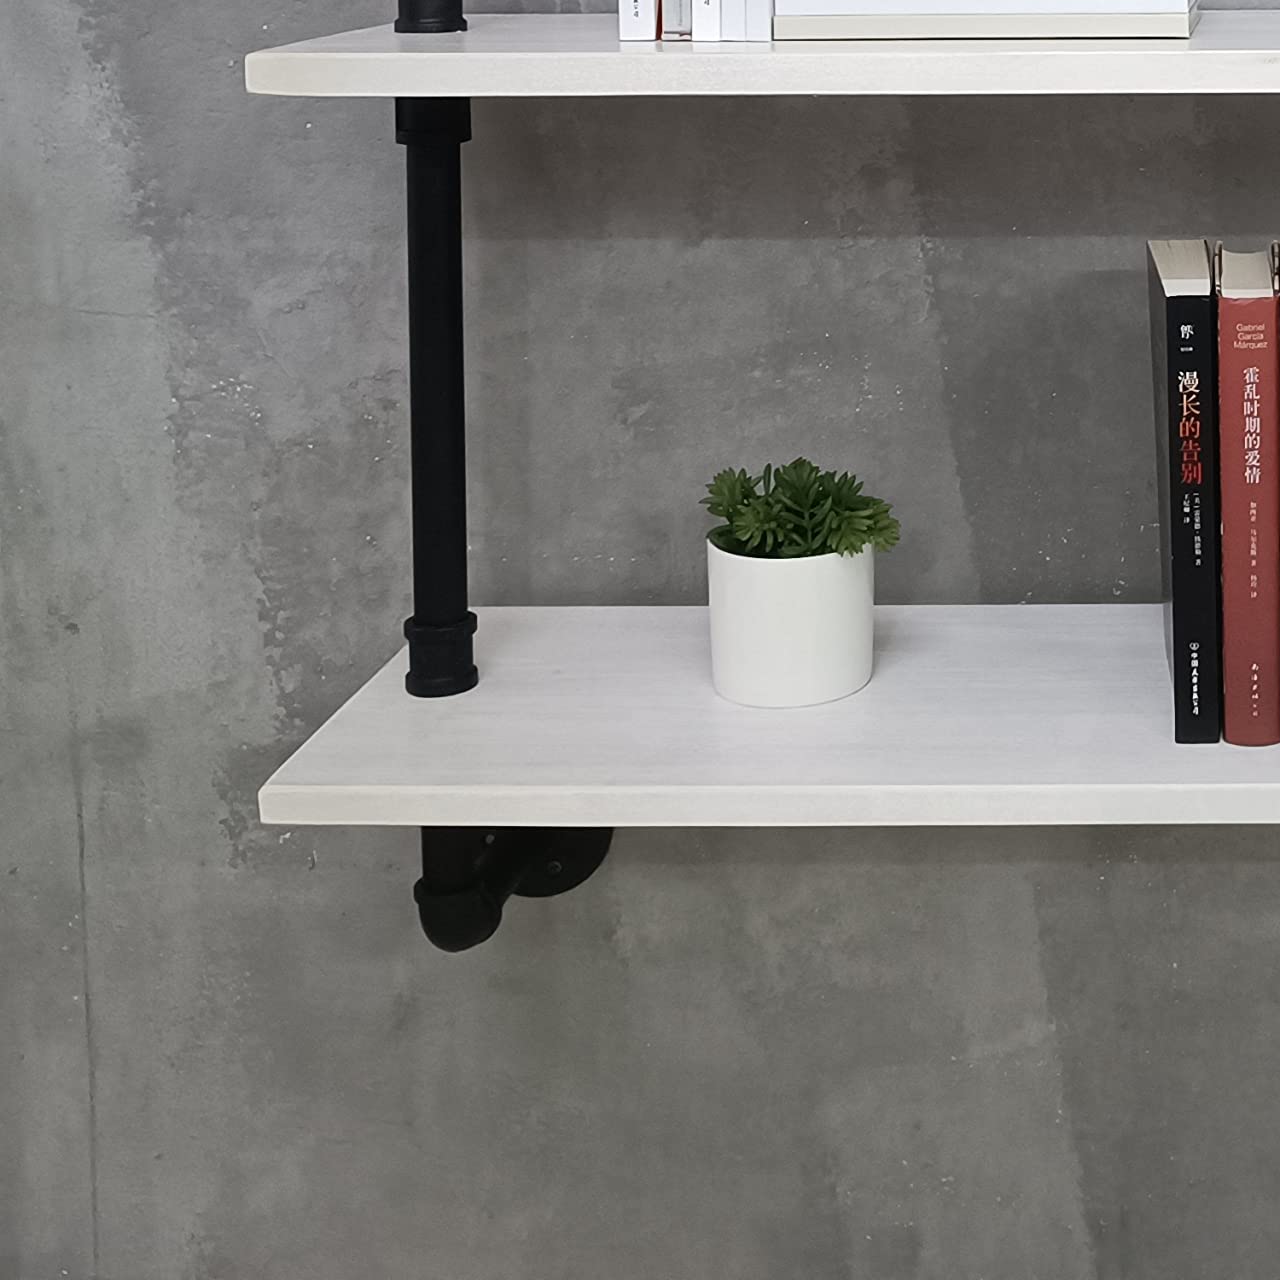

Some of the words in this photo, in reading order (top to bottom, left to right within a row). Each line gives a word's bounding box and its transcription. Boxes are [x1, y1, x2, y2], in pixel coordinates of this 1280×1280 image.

[1177, 370, 1203, 485] 漫长的告别
[1242, 366, 1262, 484] 霍乱时期的爱情
